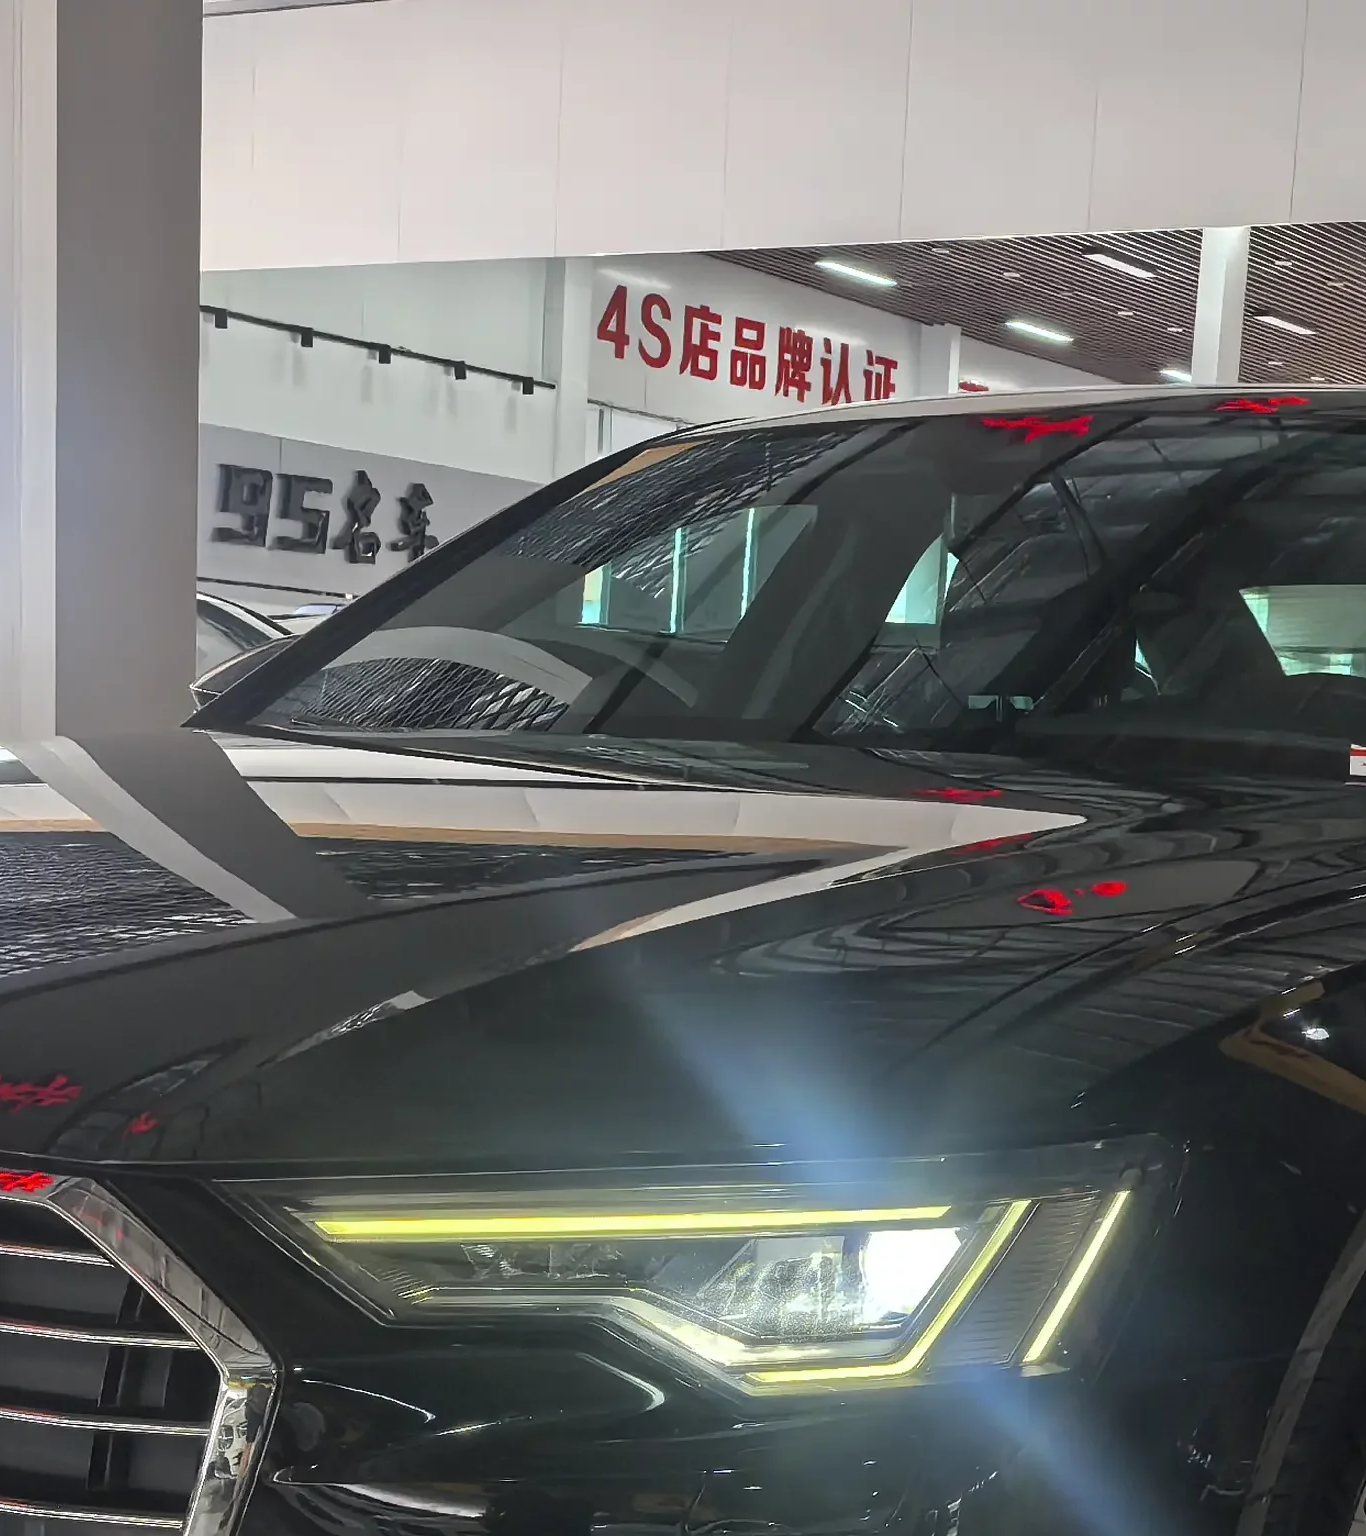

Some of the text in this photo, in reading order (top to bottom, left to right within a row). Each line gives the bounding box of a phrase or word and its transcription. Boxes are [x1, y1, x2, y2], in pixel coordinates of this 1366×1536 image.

[596, 284, 899, 406] 4S店品牌认证
[211, 463, 440, 565] 95名车
